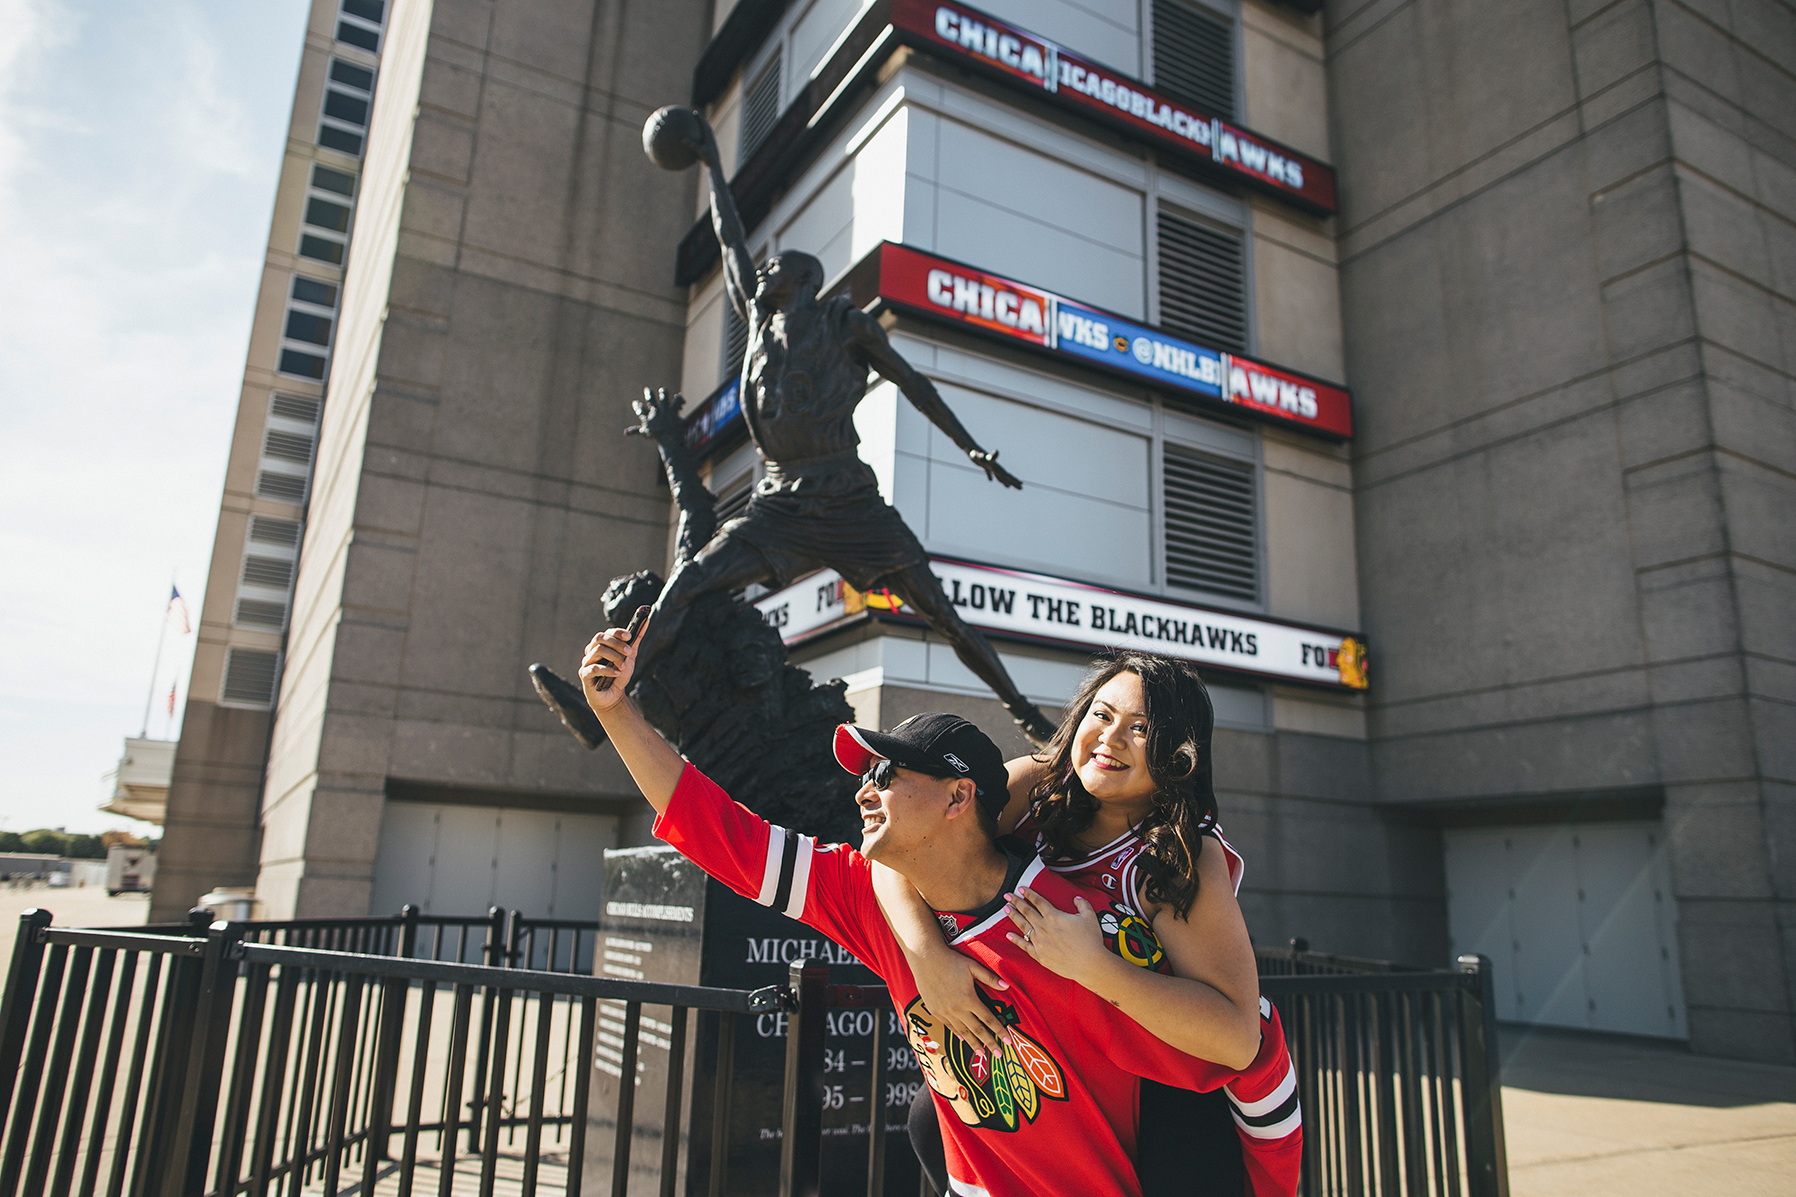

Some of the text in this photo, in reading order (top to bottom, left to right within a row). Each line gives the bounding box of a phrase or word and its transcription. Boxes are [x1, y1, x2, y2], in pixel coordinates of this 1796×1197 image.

[945, 579, 1016, 615] LOW
[1026, 593, 1080, 626] THE
[1090, 605, 1258, 656] BLACKHAWKS
[746, 938, 861, 965] MICHAE
[757, 1011, 874, 1037] CHAGO
